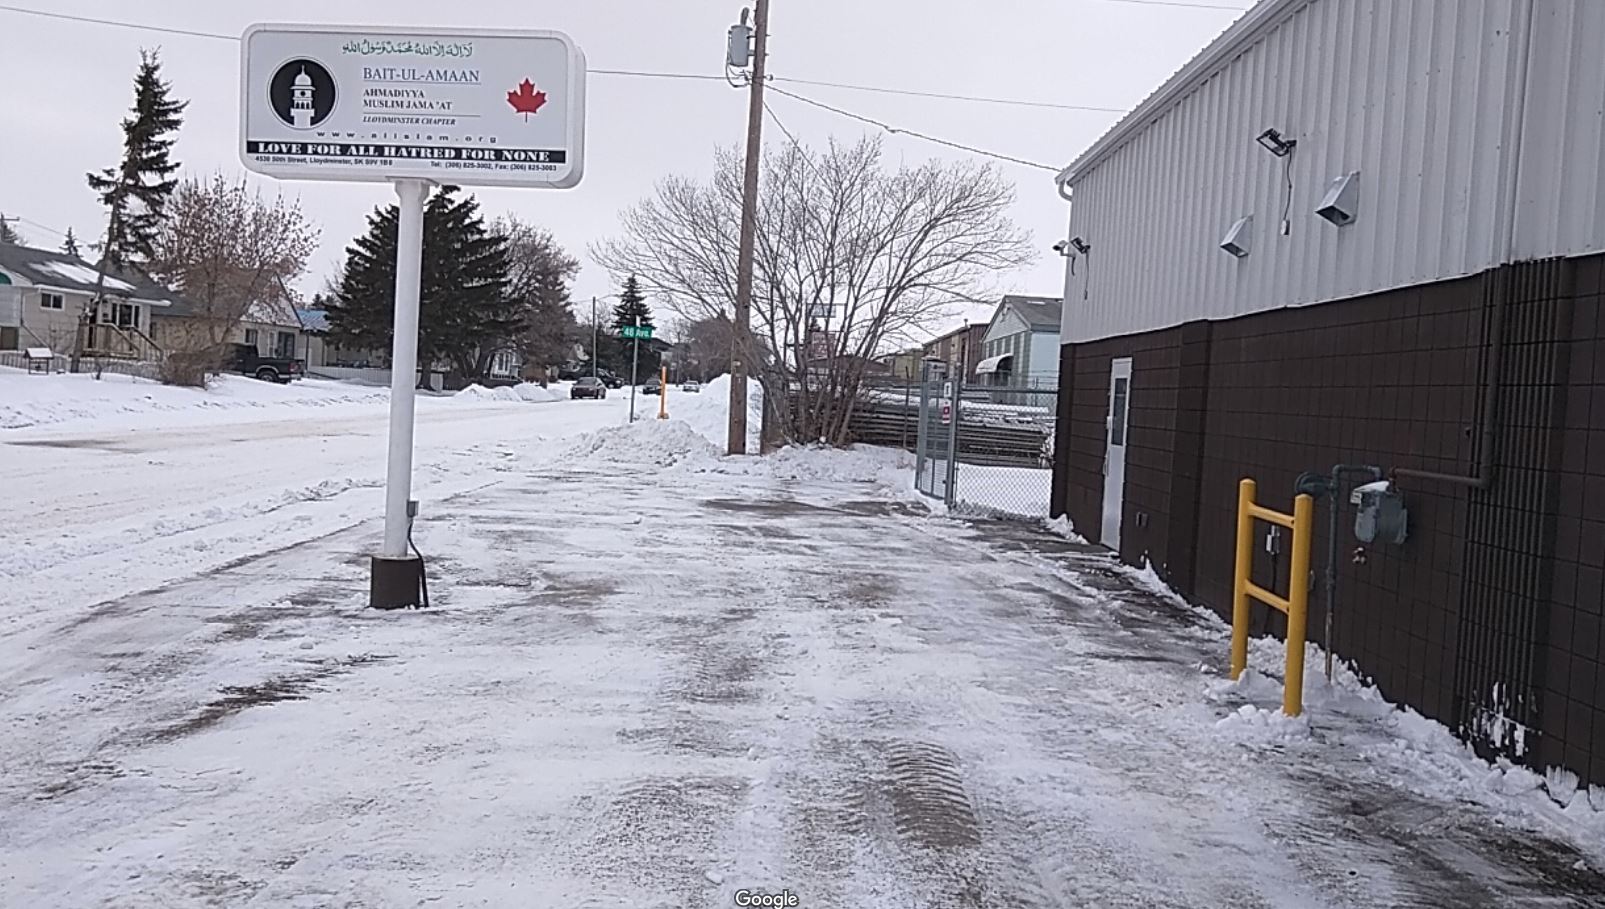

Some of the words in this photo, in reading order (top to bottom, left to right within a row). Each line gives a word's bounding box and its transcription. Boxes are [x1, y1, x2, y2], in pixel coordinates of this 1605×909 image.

[363, 67, 480, 82] BAIT-UL-AMAAN
[363, 88, 425, 98] AHMADIYYA
[363, 99, 404, 109] MUSLIM
[363, 116, 420, 125] LLOYDMINSTER
[421, 118, 456, 126] CHAPTER
[258, 142, 302, 154] LOVE
[307, 143, 341, 155] FOR
[347, 144, 379, 156] ALL
[384, 146, 456, 159] HATRED
[461, 148, 496, 161] FOR
[502, 150, 550, 162] NONE
[287, 156, 308, 165] Street,
[309, 157, 353, 166] Lloydminster,
